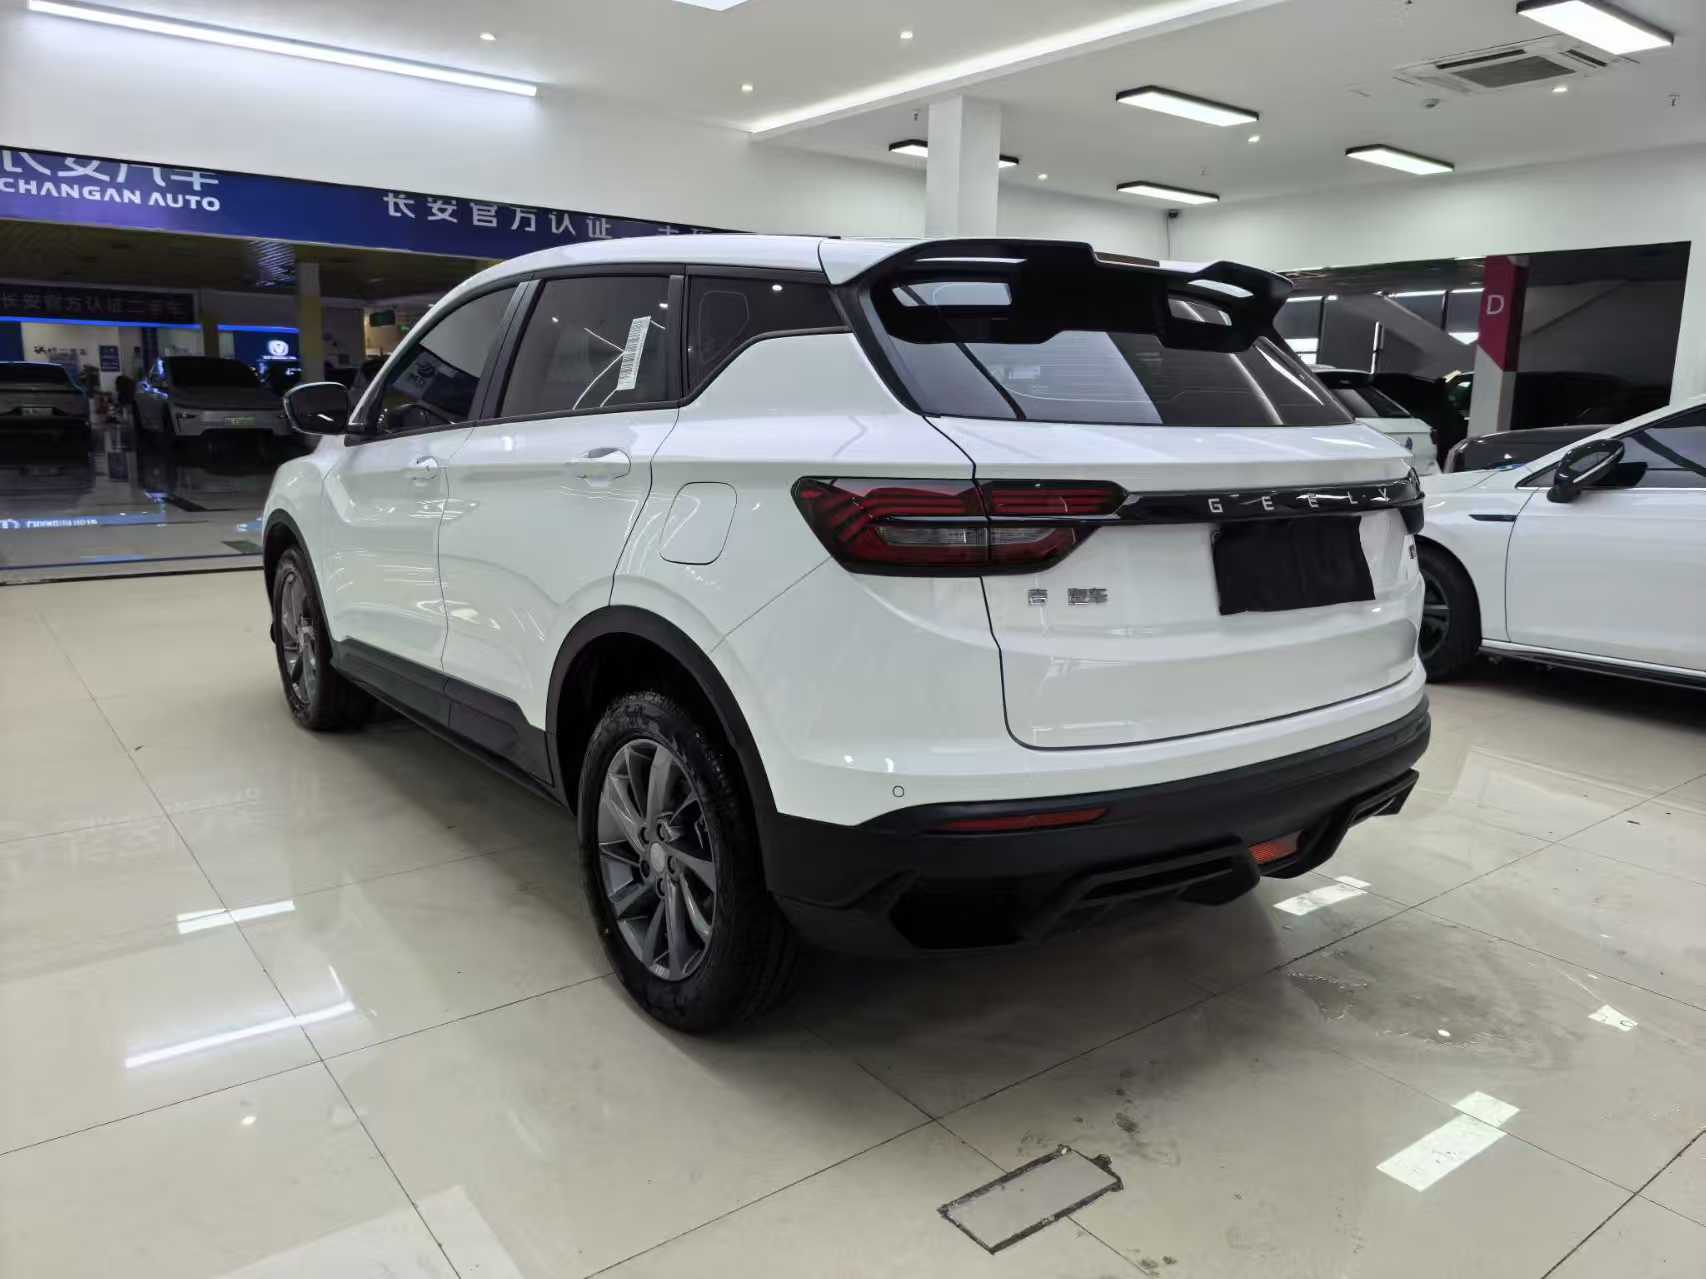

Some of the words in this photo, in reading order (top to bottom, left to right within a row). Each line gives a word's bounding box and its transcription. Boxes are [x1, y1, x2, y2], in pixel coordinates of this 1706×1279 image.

[0, 178, 142, 204] CHANGAN
[148, 192, 221, 212] AUTO
[383, 192, 612, 240] 长安官方认证
[1487, 295, 1504, 315] D
[1207, 488, 1388, 513] GEELY
